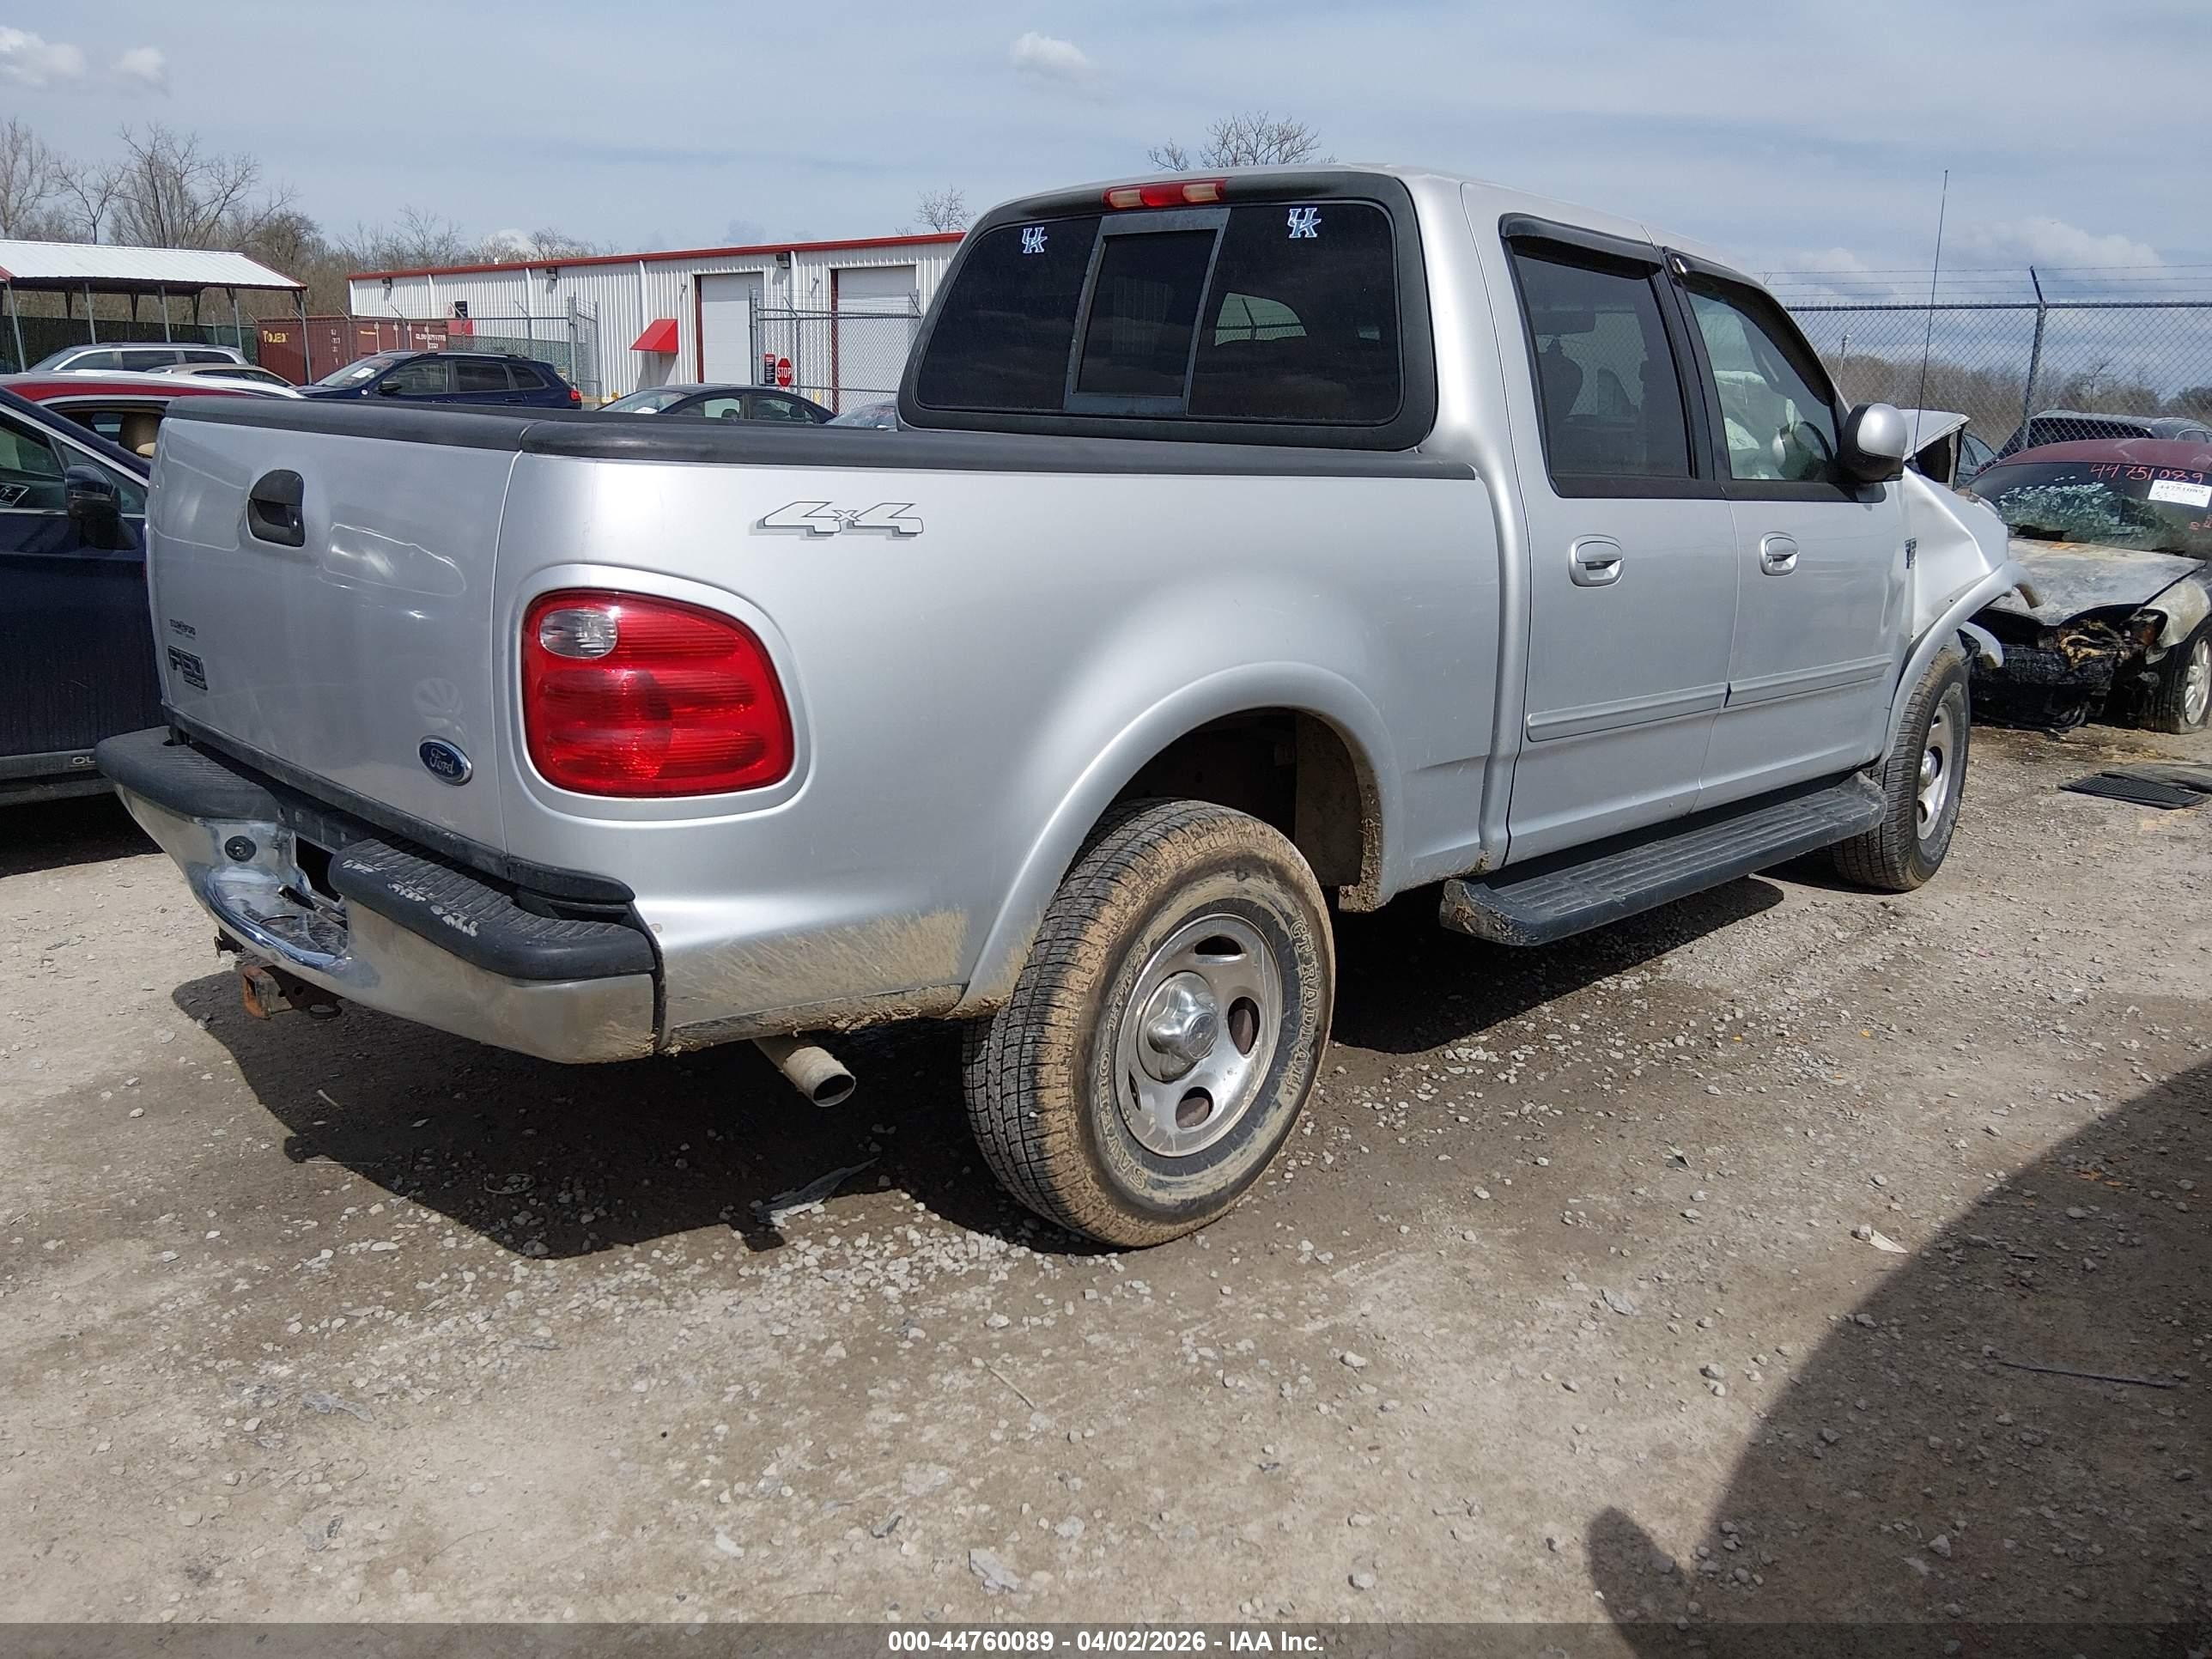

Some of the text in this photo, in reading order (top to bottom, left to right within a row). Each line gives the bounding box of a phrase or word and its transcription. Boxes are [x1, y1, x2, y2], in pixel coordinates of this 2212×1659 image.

[1287, 208, 1322, 239] UK
[1022, 227, 1048, 254] UK
[777, 367, 792, 379] STOP
[2090, 465, 2203, 483] 44751089
[756, 501, 924, 538] 4x4
[429, 747, 454, 775] Ford
[1290, 921, 1316, 954] GT
[1099, 1050, 1148, 1189] SAVERO
